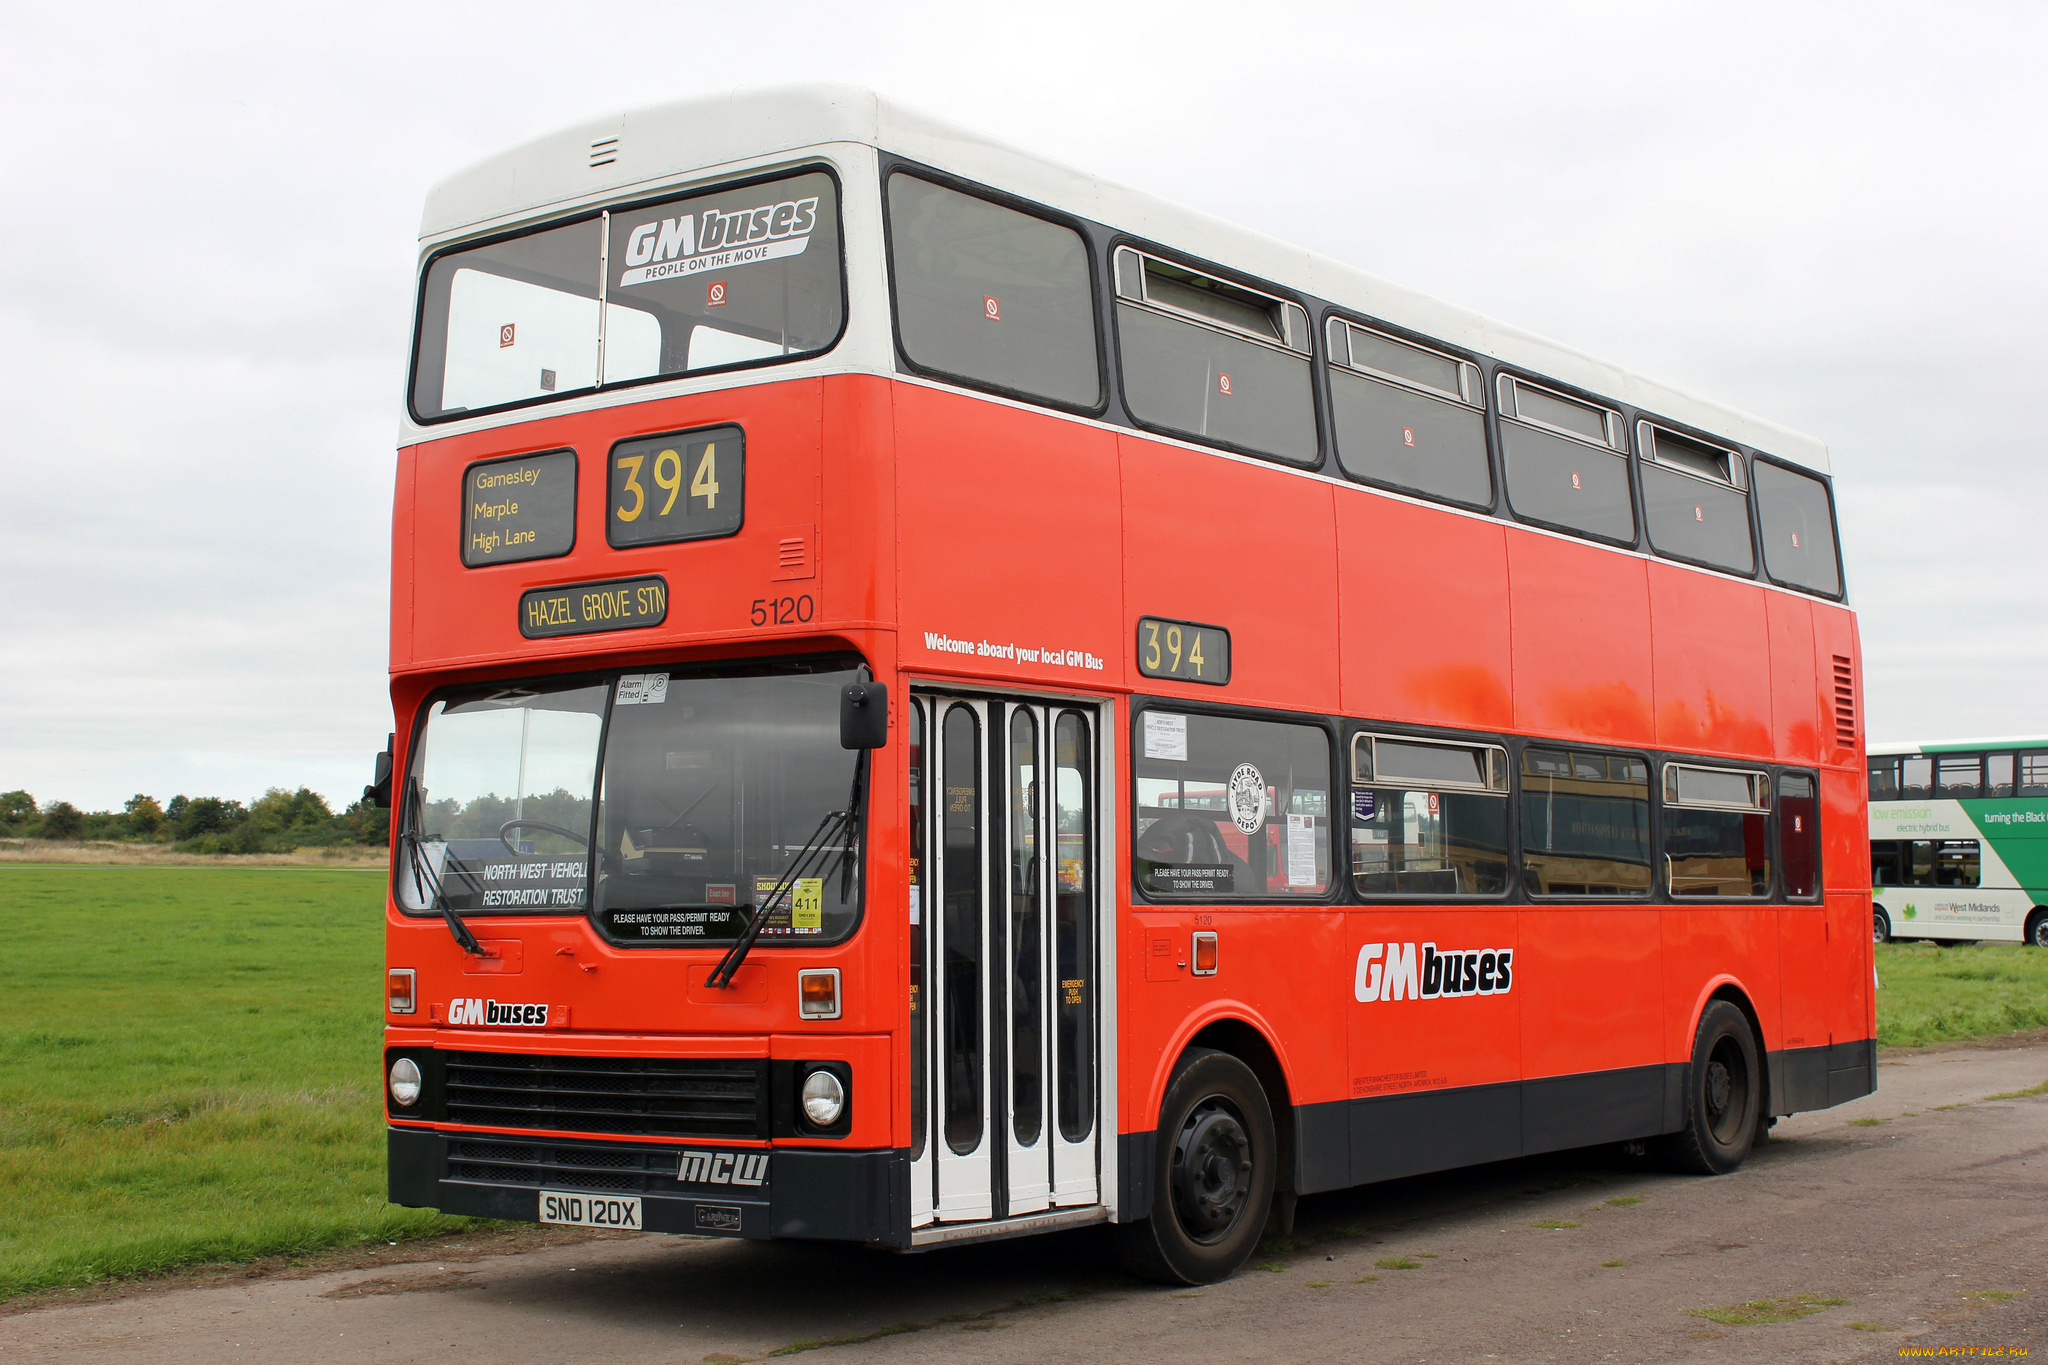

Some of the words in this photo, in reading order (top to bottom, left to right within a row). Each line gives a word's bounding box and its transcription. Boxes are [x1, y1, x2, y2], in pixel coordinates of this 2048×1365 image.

[645, 261, 685, 279] PEOPLE
[689, 258, 706, 270] ON
[710, 253, 730, 266] THE
[734, 247, 768, 262] MOVE
[476, 466, 541, 490] Gamesley
[616, 443, 719, 523] 394
[474, 498, 519, 522] Marple
[472, 530, 500, 554] High
[505, 528, 536, 546] Lane
[528, 597, 576, 627] HAZEL
[581, 589, 630, 622] GROVE
[637, 586, 665, 615] STN
[750, 594, 814, 627] 5120
[924, 632, 975, 655] Welcome
[976, 639, 1014, 660] aboard
[1016, 647, 1040, 665] your
[1041, 646, 1064, 666] local
[1066, 650, 1084, 668] GM
[1085, 652, 1104, 670] Bus
[1145, 620, 1205, 677] 394
[620, 680, 642, 688] Alarm
[618, 690, 640, 698] Fitted
[1231, 768, 1244, 791] HYDE
[1246, 768, 1262, 791] ROAD
[1872, 807, 1889, 820] low
[1890, 806, 1932, 820] emission
[1984, 812, 2012, 825] turning
[2012, 812, 2025, 823] the
[2026, 811, 2046, 823] Black
[1236, 817, 1258, 830] DEPOT
[1896, 824, 1918, 832] electric
[1919, 823, 1938, 834] hybrid
[1938, 823, 1951, 832] bus
[484, 864, 518, 880] NORTH
[520, 863, 548, 879] WEST
[1154, 868, 1170, 877] PLEASE
[1170, 868, 1180, 877] HAVE
[1180, 869, 1192, 877] YOUR
[1216, 870, 1230, 878] READY
[1173, 880, 1178, 888] TO
[1179, 880, 1192, 888] SHOW
[1192, 880, 1200, 888] THE
[482, 888, 549, 906] RESTORATION
[551, 888, 584, 904] TRUST
[709, 889, 720, 898] Exact
[795, 898, 818, 910] 411
[1948, 902, 1967, 912] West
[1968, 903, 2001, 912] Midlands
[614, 914, 636, 924] PLEASE
[636, 913, 652, 923] HAVE
[652, 913, 669, 923] YOUR
[670, 912, 708, 924] PASS/PERMIT
[710, 912, 730, 922] READY
[1194, 916, 1212, 925] 5120
[640, 926, 650, 936] TO
[650, 926, 668, 936] SHOW
[669, 926, 682, 935] THE
[682, 926, 706, 935] DRIVER.
[1062, 980, 1084, 988] EMERGENCY
[1382, 1082, 1398, 1091] STREET
[677, 1151, 769, 1187] MCW
[546, 1196, 582, 1222] SND
[588, 1199, 636, 1226] 120X
